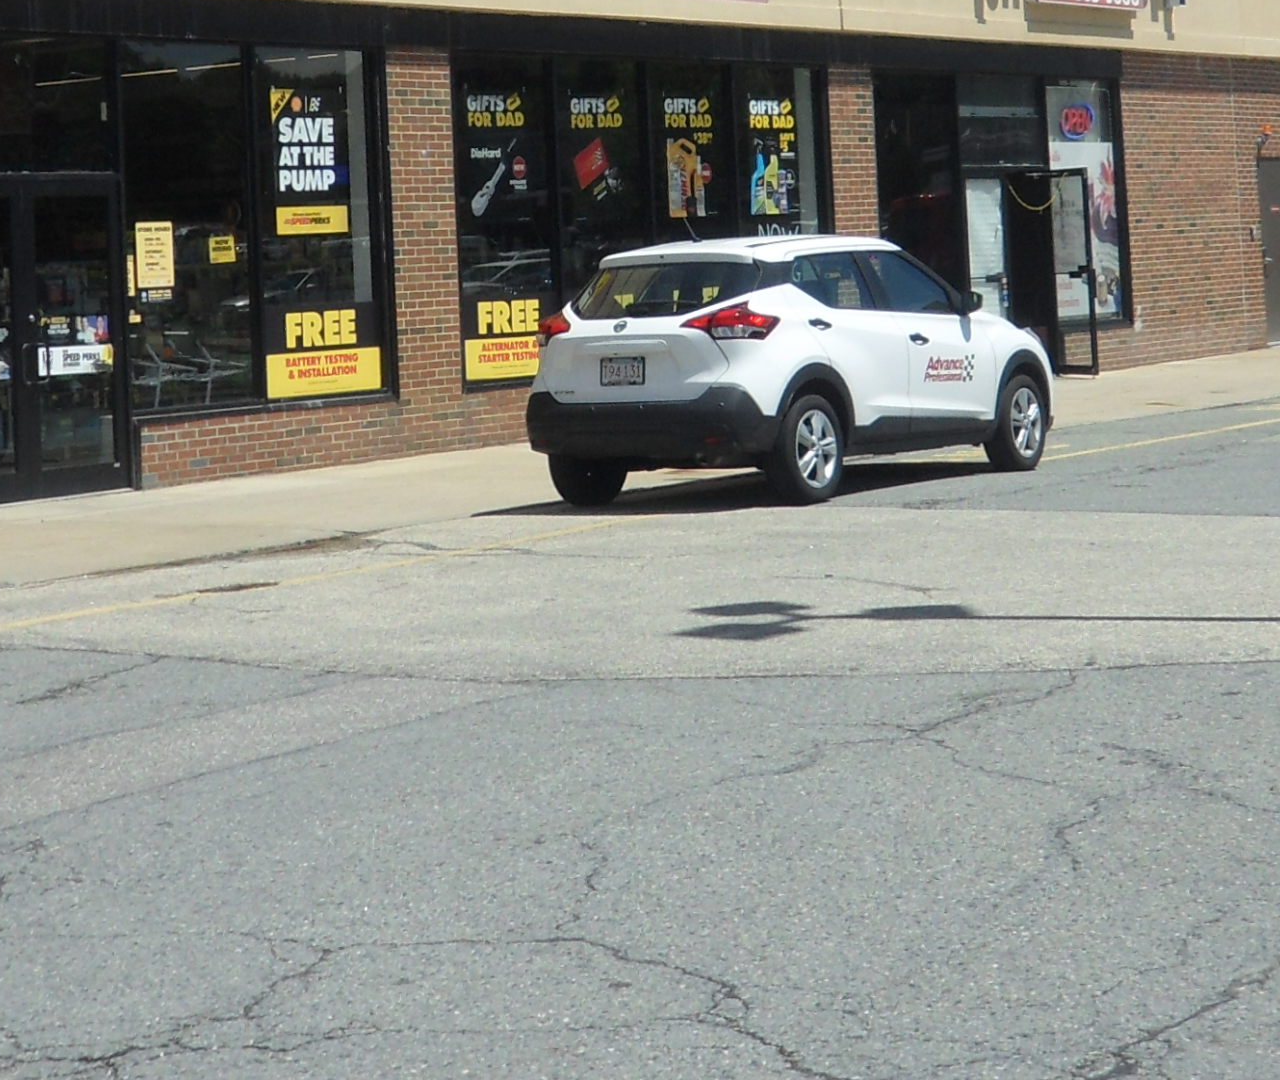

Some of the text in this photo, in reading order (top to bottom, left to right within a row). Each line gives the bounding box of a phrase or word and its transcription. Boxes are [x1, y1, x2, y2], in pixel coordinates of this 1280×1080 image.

[272, 91, 287, 115] NEW
[466, 95, 505, 111] GIFTS
[570, 98, 605, 114] GIFTS
[664, 98, 697, 114] GIFTS
[749, 99, 780, 115] GIFTS
[467, 111, 524, 127] FOR DAD
[570, 113, 623, 129] FOR DAD
[664, 114, 712, 128] FOR DAD
[749, 114, 795, 129] FOR DAD
[1061, 108, 1093, 133] OPEN
[278, 117, 335, 143] SAVE
[278, 146, 335, 167] AT THE
[279, 169, 336, 192] PUMP
[477, 299, 540, 335] FREE
[285, 309, 357, 349] FREE
[481, 341, 529, 352] ALTERNATOR
[285, 353, 359, 368] BATTERY TESTING
[478, 353, 510, 363] STARTER
[926, 356, 964, 371] Advance
[288, 365, 357, 380] & INSTALLATION
[623, 364, 641, 379] 131
[924, 371, 964, 383] Professional
